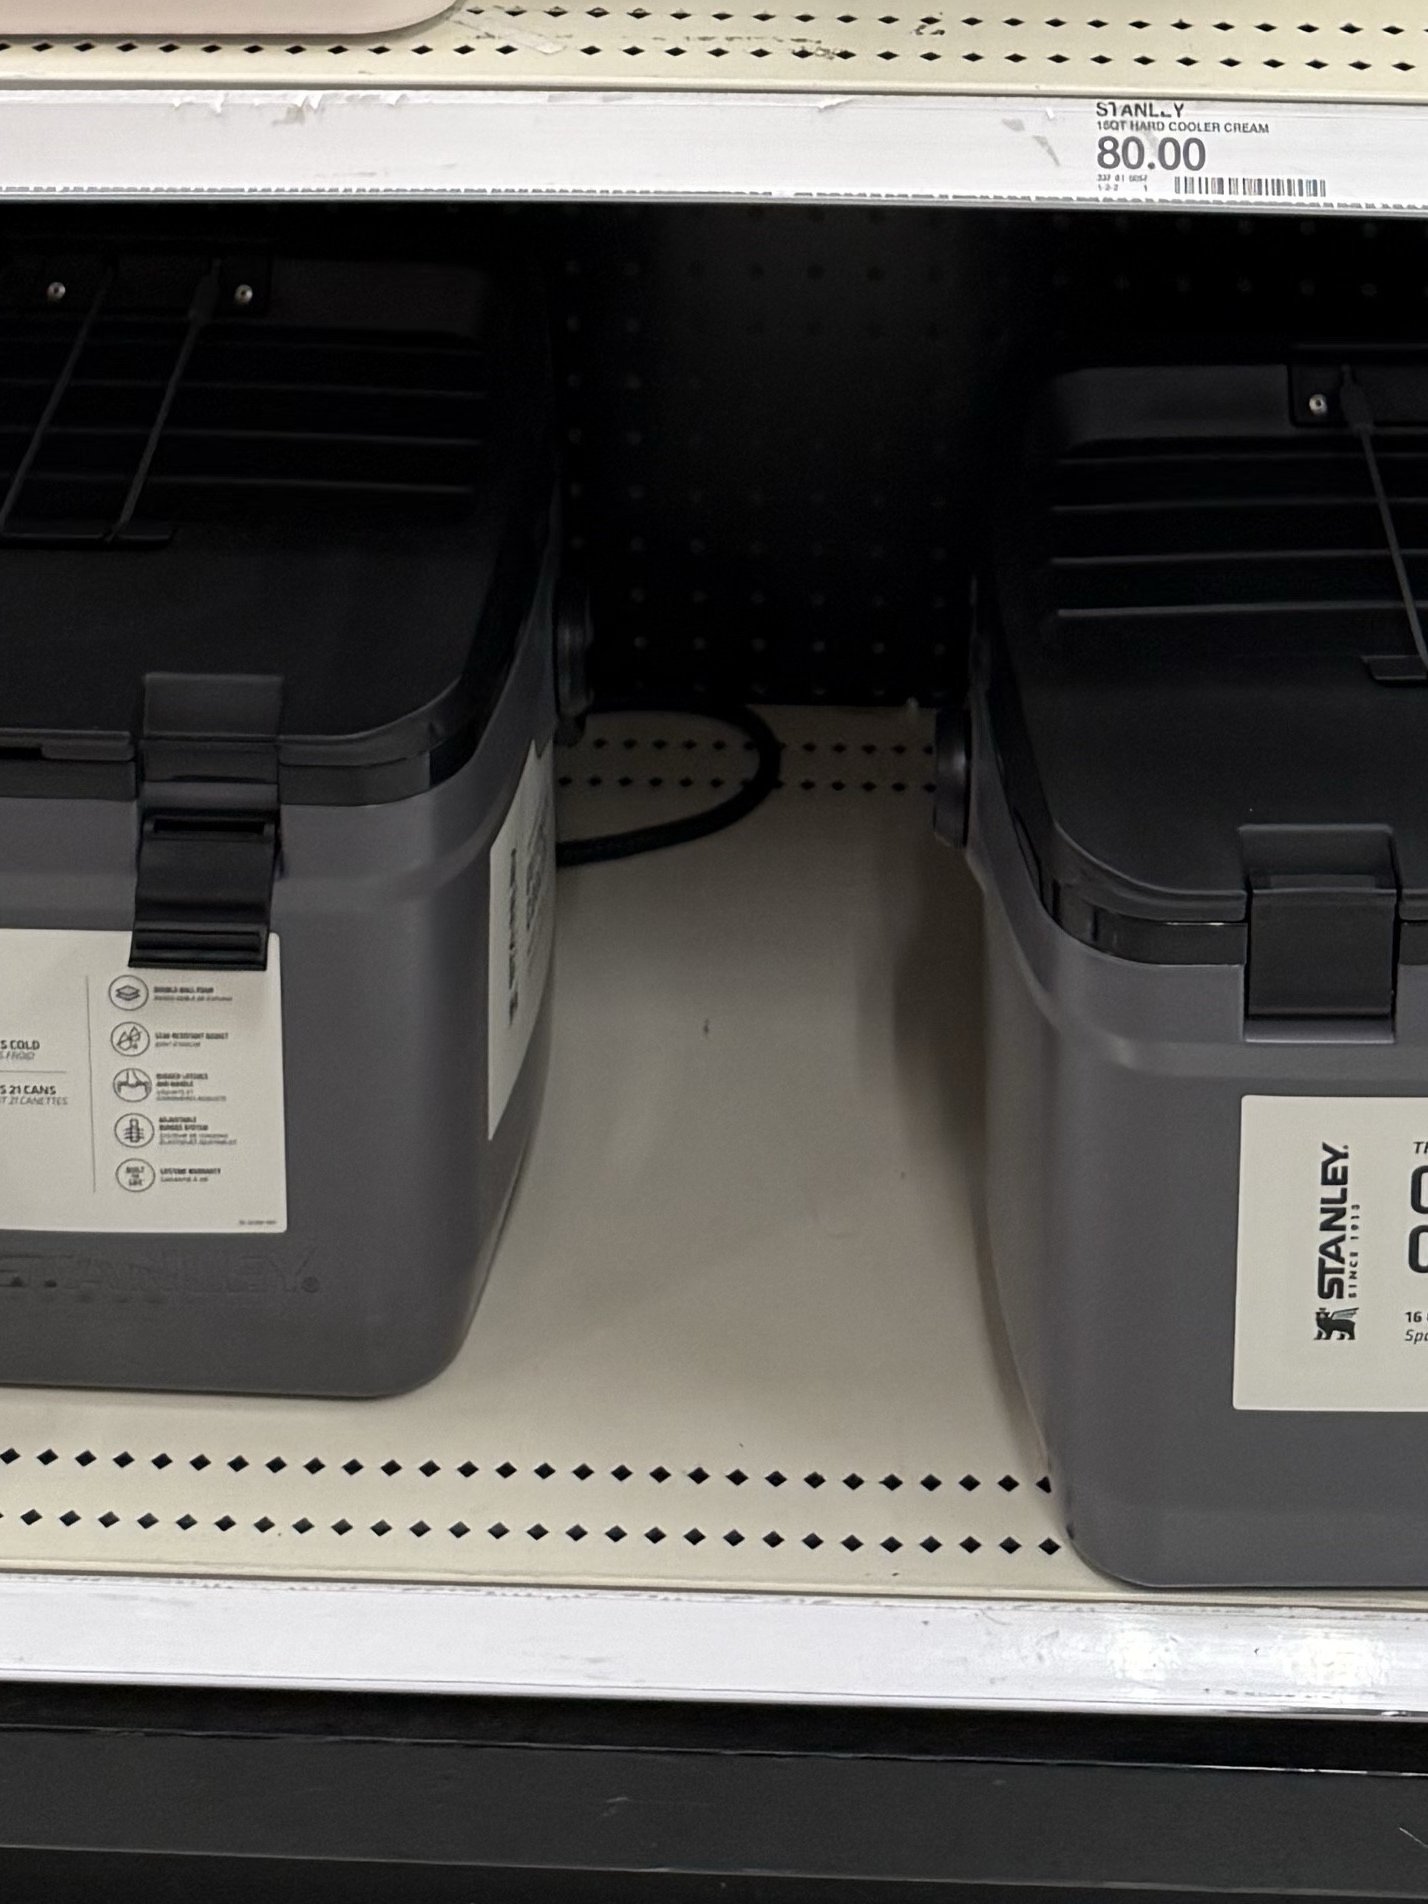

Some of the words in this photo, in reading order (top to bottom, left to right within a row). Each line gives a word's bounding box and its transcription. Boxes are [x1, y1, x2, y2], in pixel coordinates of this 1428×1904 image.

[1129, 121, 1165, 132] HARD
[1168, 122, 1220, 133] COOLER
[1224, 122, 1269, 134] CREAM
[1097, 135, 1206, 171] 80.00
[1317, 1142, 1350, 1300] STANLEY
[1405, 1310, 1422, 1323] 16
